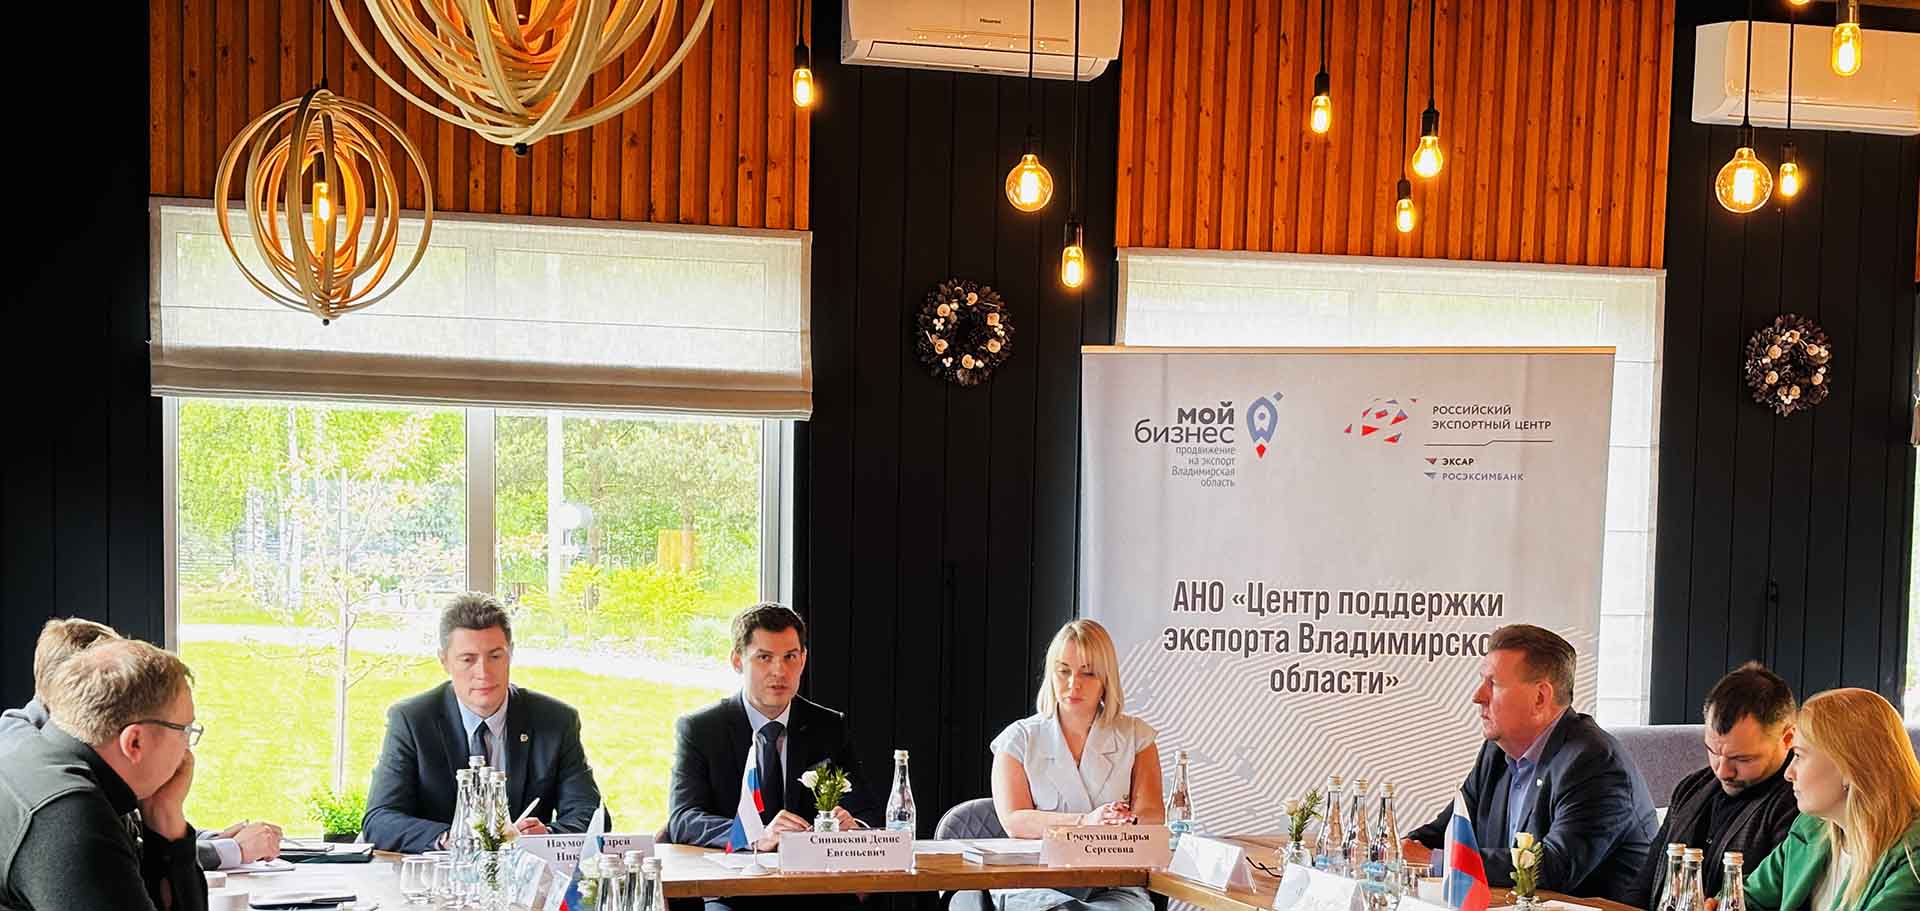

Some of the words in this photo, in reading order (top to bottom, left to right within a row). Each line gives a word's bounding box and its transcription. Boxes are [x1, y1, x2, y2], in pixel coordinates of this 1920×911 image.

[1177, 401, 1234, 424] мой
[1432, 404, 1512, 415] РОССИЙСКИЙ
[1431, 419, 1511, 430] ЭКСПОРТНЫЙ
[1514, 420, 1552, 431] ЦЕНТР
[1134, 419, 1235, 444] бизнес
[1175, 446, 1236, 456] продвижение
[1188, 458, 1200, 466] на
[1201, 457, 1236, 467] экспорт
[1441, 458, 1475, 466] ЭКСАР
[1171, 466, 1236, 477] Владимирская
[1441, 473, 1524, 481] РОСЭКСИМБАНК
[1200, 476, 1236, 488] область
[1172, 581, 1224, 613] АНО
[1231, 581, 1330, 619] «Центр
[1338, 590, 1504, 622] поддержки
[1163, 626, 1290, 658] экспорта
[1298, 622, 1490, 662] Владимирско
[1270, 663, 1399, 694] области»
[870, 835, 901, 844] Денис
[1119, 832, 1150, 841] Дарья
[827, 848, 886, 857] Евгеньевич
[1084, 844, 1134, 855] Сергеевна
